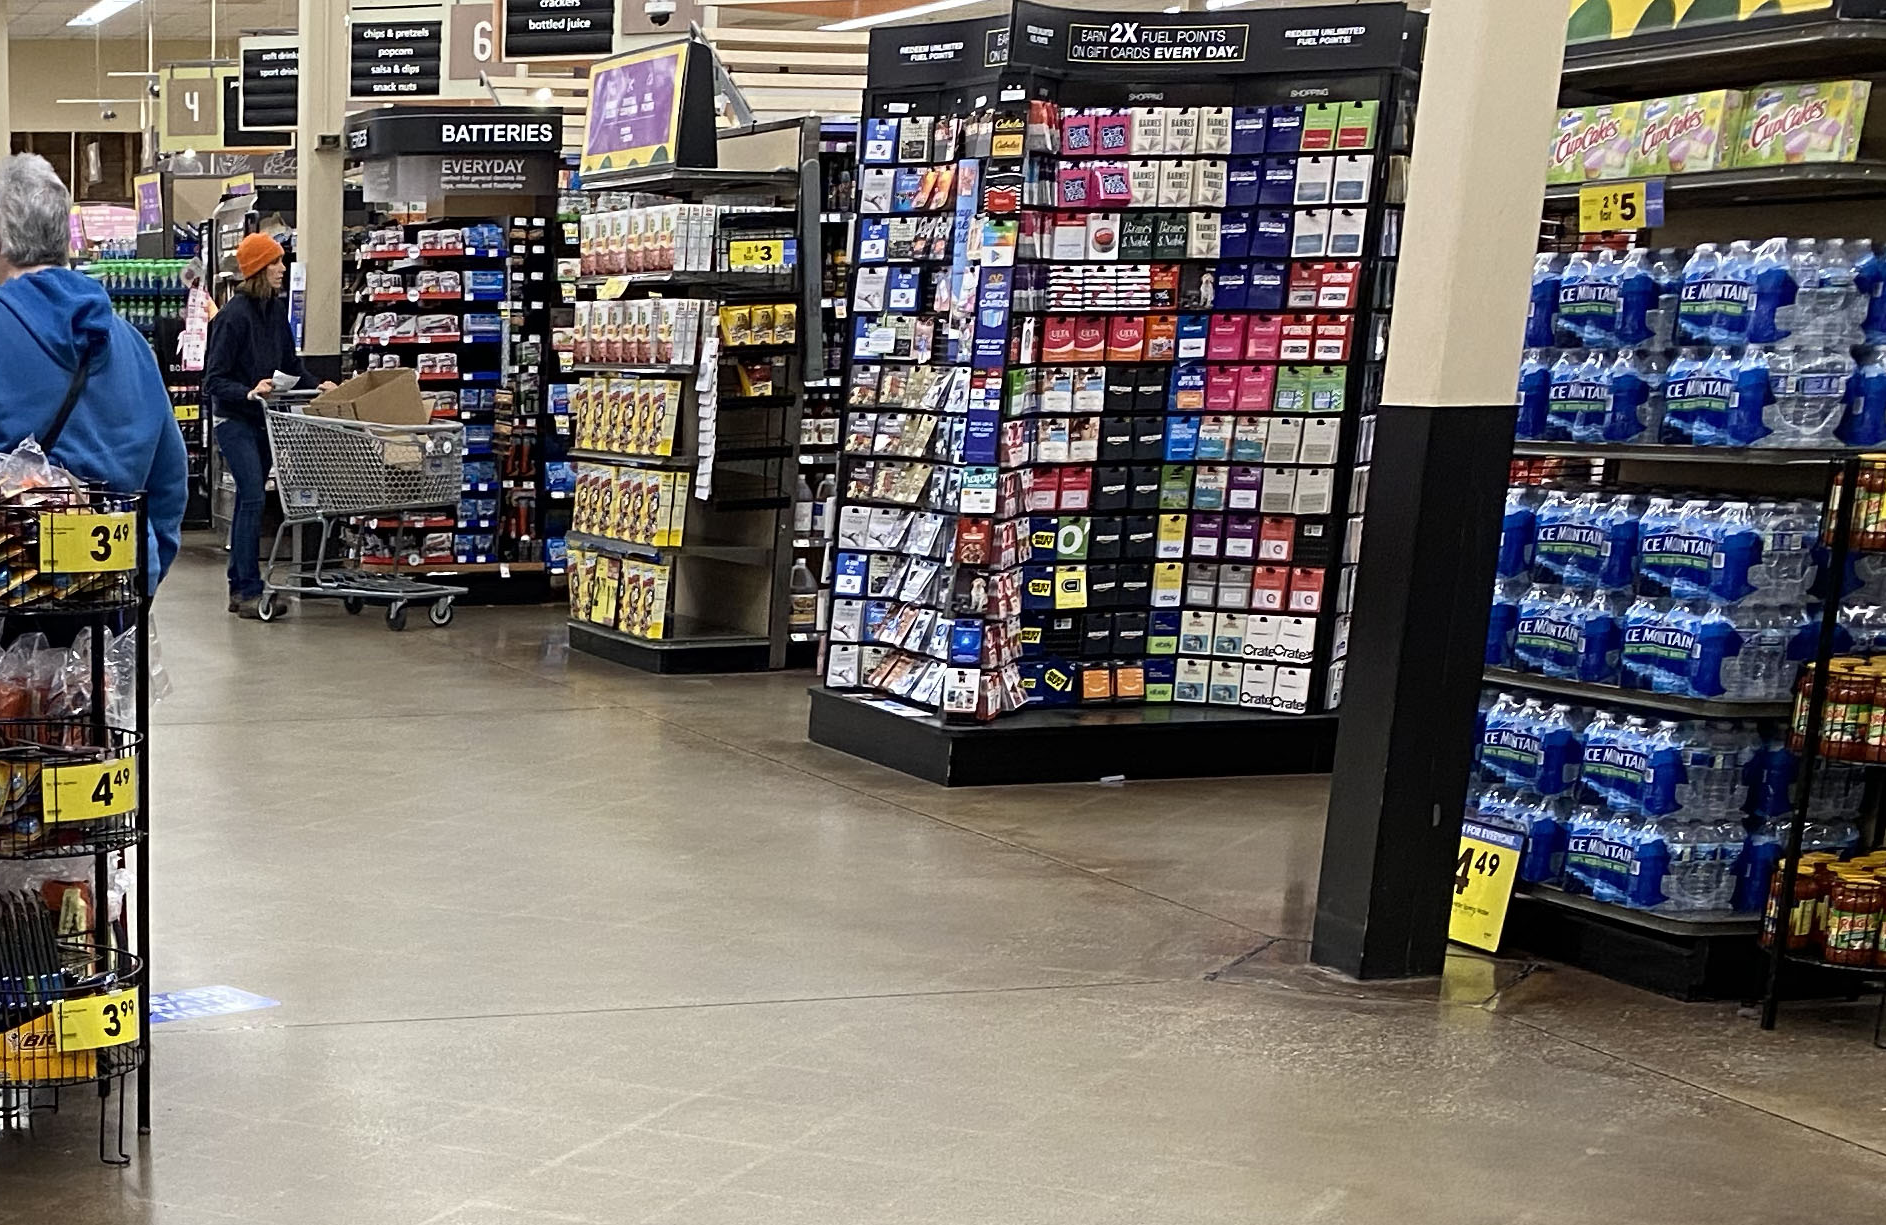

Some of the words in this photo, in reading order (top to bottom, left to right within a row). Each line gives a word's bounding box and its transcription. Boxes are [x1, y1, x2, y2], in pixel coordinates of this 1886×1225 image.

[528, 18, 565, 31] bottled
[567, 18, 591, 31] juice
[364, 29, 385, 39] chips
[387, 29, 394, 38] &
[396, 28, 429, 39] pretzels
[473, 20, 492, 62] 6
[1081, 30, 1107, 43] EARN
[1109, 23, 1139, 44] 2X
[1142, 30, 1173, 43] FUEL
[1177, 30, 1226, 43] POINTS
[378, 47, 413, 58] popcorn
[1072, 45, 1085, 58] ON
[1086, 46, 1108, 59] GIFT
[1110, 47, 1151, 59] CARDS
[1154, 46, 1201, 59] EVERY
[280, 68, 299, 77] drink
[371, 64, 391, 74] salsa
[393, 64, 400, 74] &
[402, 64, 420, 75] dips
[373, 82, 396, 92] snack
[398, 82, 417, 92] nuts
[1290, 88, 1329, 98] SHOPPING
[1129, 92, 1164, 101] SHOPPING
[184, 91, 200, 122] 4
[1749, 97, 1828, 149] CupCakes
[441, 124, 553, 143] BATTERIES
[1641, 109, 1706, 156] CupCakes
[1555, 117, 1622, 164] CupCakes
[441, 159, 525, 174] EVERYDAY
[1603, 196, 1609, 209] 2
[1620, 192, 1637, 221] 5
[1600, 209, 1613, 222] for
[760, 246, 772, 261] 3
[980, 299, 1009, 308] CARDS
[985, 292, 1005, 300] GIFT
[963, 470, 997, 487] happy
[90, 525, 112, 562] 3
[113, 524, 129, 542] 49
[1642, 538, 1662, 552] ICE
[1243, 644, 1274, 656] Crate
[1275, 644, 1306, 659] Crate
[91, 772, 113, 807] 4
[114, 768, 130, 787] 49
[1467, 825, 1482, 837] FOR
[1452, 847, 1475, 895] 4
[1475, 850, 1500, 877] 49
[102, 1003, 121, 1037] 3
[120, 1000, 134, 1018] 99
